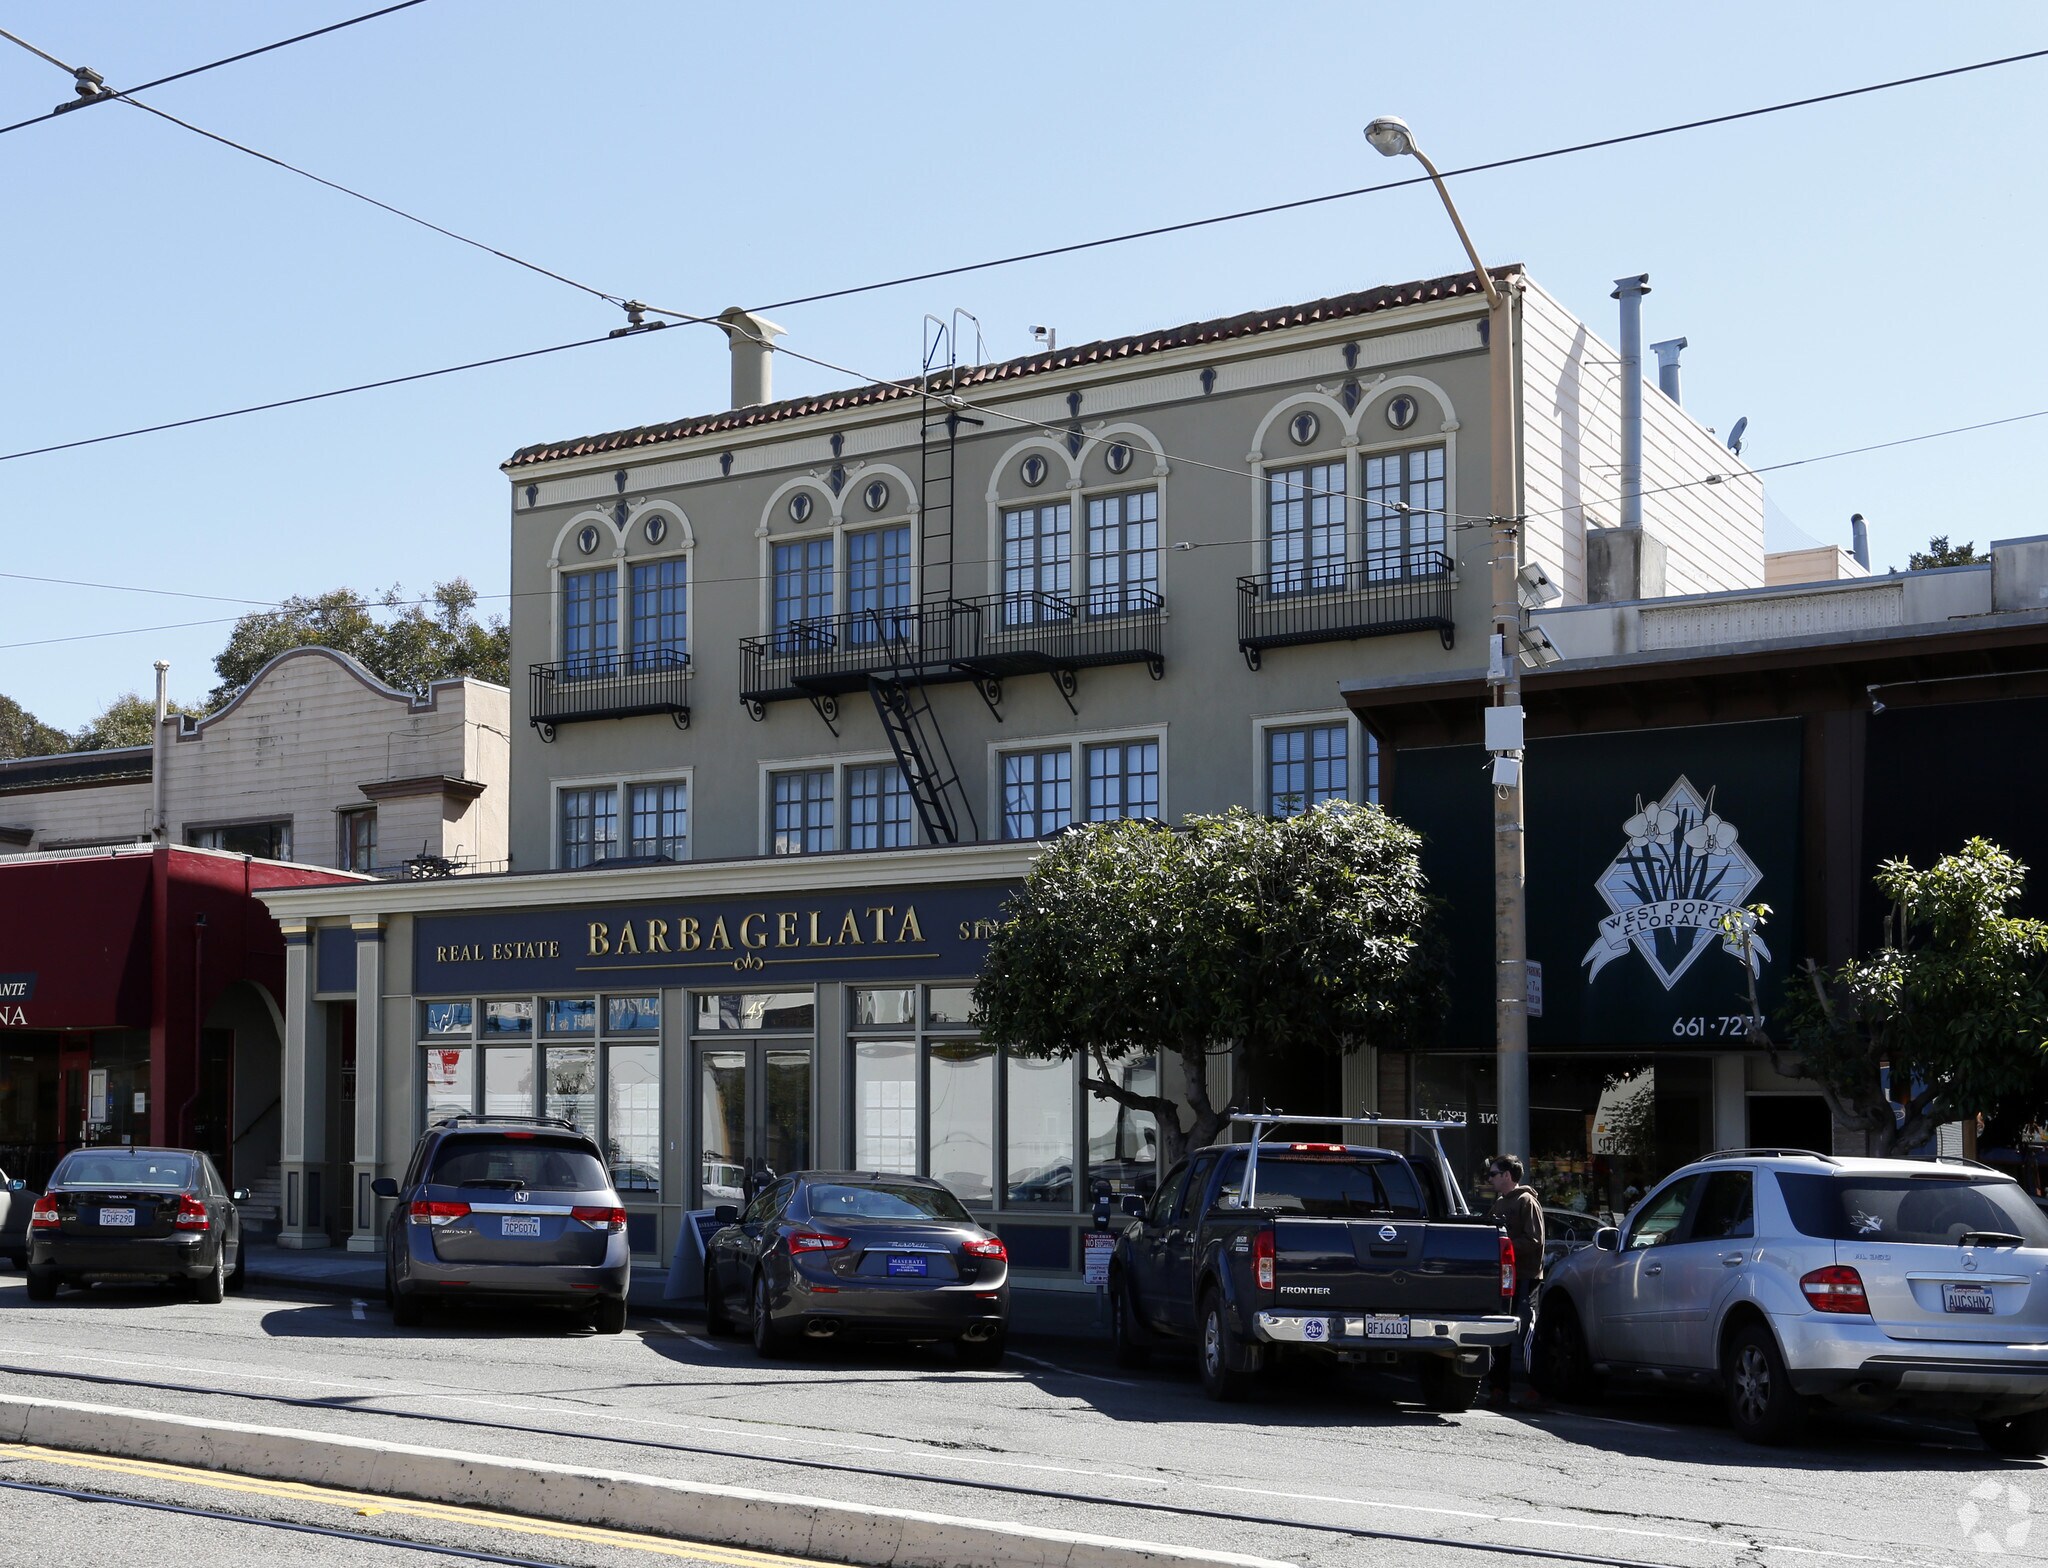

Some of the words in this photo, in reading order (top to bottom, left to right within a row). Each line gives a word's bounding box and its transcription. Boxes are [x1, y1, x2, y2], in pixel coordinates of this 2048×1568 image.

[1606, 904, 1659, 929] WEST
[1671, 902, 1734, 918] PORTA
[587, 905, 926, 957] BARBAGELATA
[1623, 914, 1703, 936] FLORAL
[436, 944, 485, 962] REAL
[492, 941, 560, 960] ESTATE
[102, 1214, 133, 1224] 7CHF290
[1085, 1239, 1095, 1247] NO
[1280, 1286, 1331, 1294] FRONTIER
[1306, 1325, 1322, 1334] 2014
[1367, 1322, 1408, 1335] 8F16103
